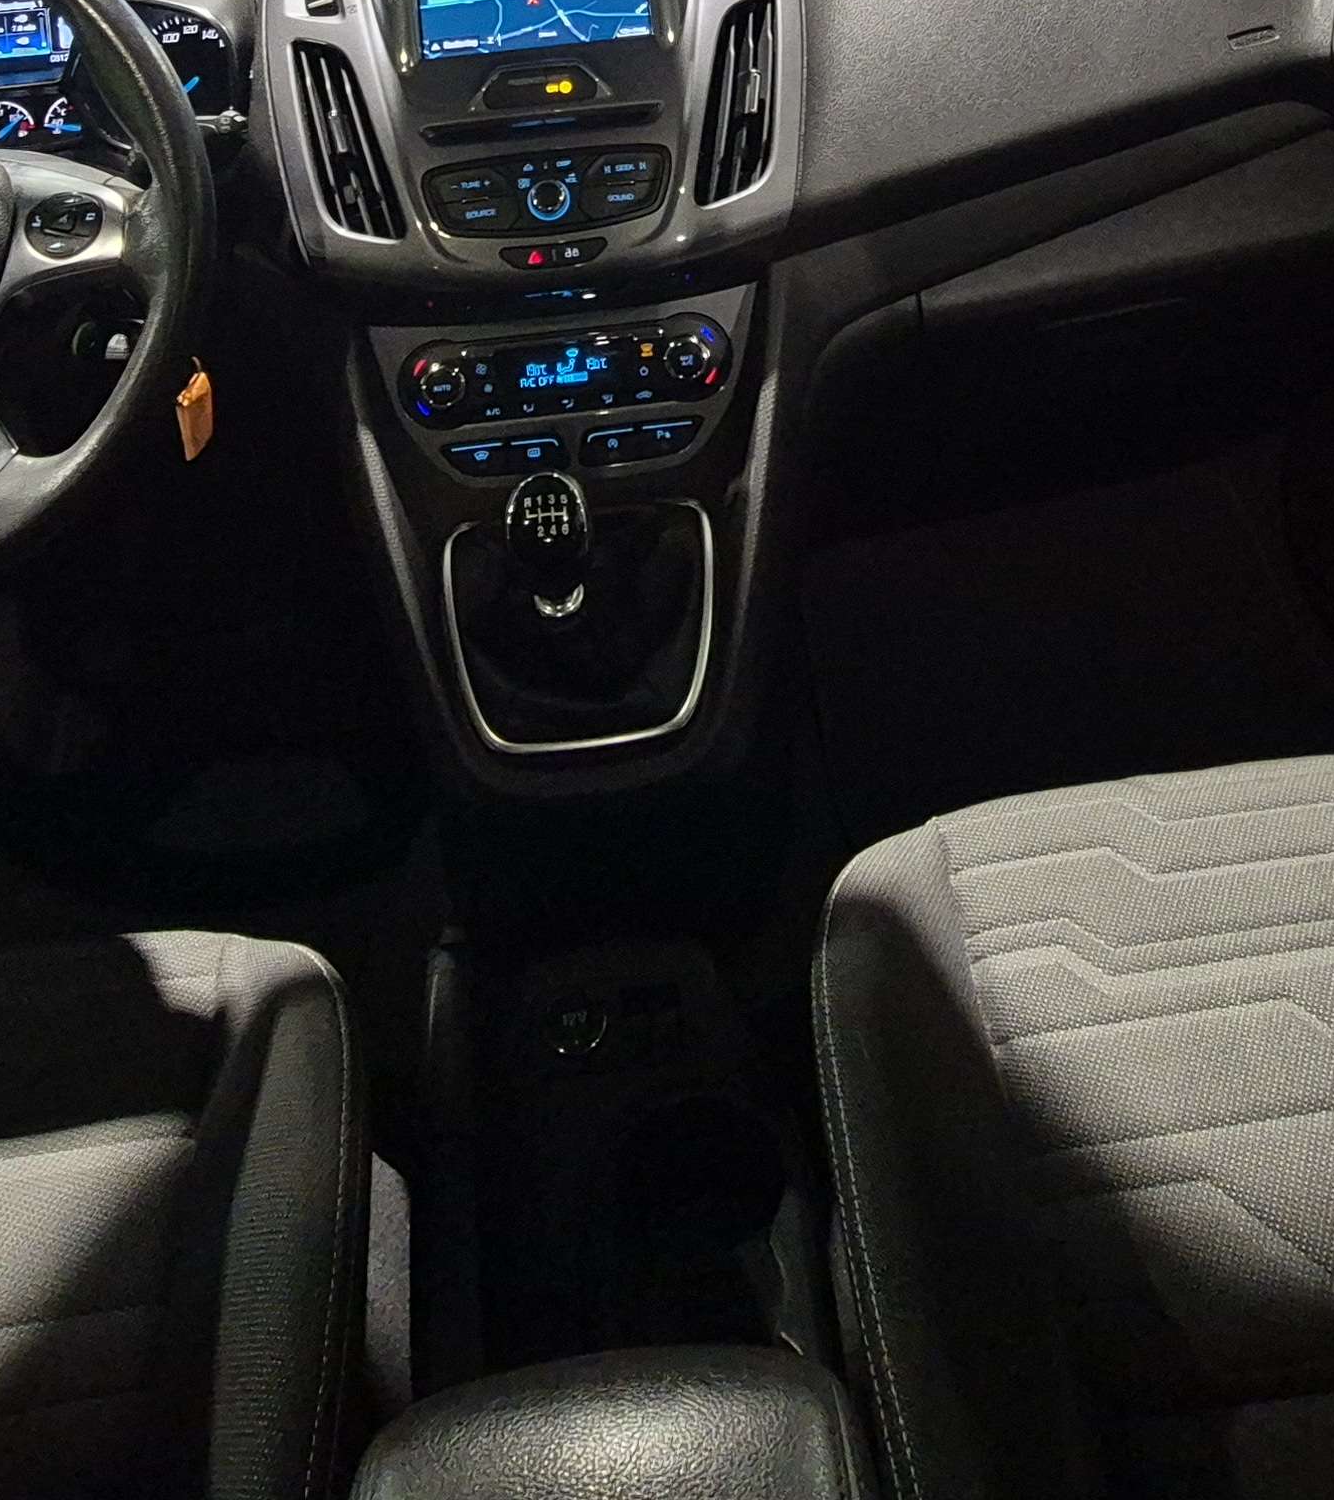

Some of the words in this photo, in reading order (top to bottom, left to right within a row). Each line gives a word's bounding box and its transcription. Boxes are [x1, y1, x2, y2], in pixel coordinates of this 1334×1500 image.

[183, 25, 198, 35] 120
[162, 33, 180, 43] 100
[538, 375, 555, 387] OFF
[536, 494, 542, 506] 1
[548, 494, 555, 505] 3
[560, 494, 568, 504] 5
[537, 525, 544, 537] 2
[550, 524, 557, 536] 4
[561, 523, 569, 535] 6
